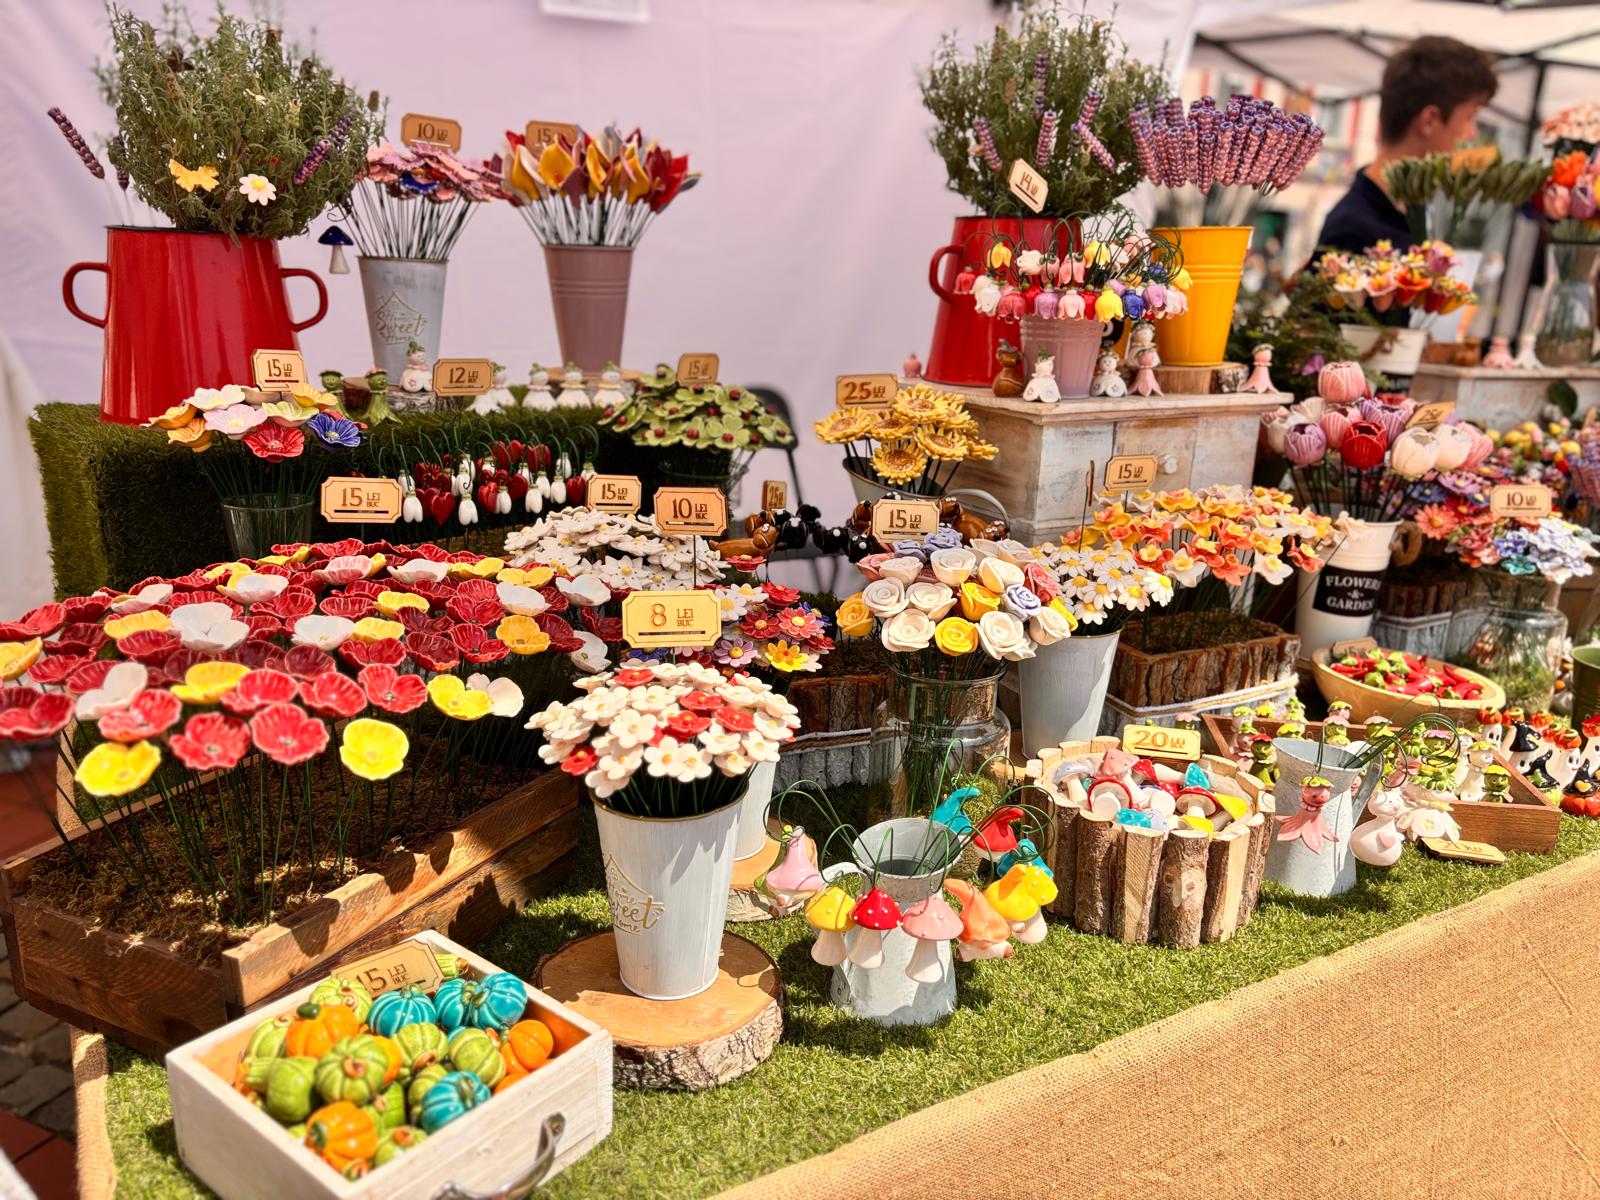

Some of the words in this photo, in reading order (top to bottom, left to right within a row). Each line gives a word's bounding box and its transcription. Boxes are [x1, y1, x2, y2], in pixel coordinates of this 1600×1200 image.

[417, 122, 435, 139] 10
[537, 127, 551, 143] 15
[375, 311, 425, 336] Sweet
[267, 358, 282, 377] 15
[449, 367, 466, 384] 12
[688, 359, 700, 376] 15
[843, 381, 872, 400] 25
[1118, 463, 1133, 479] 15
[341, 487, 363, 507] 15
[366, 492, 381, 500] LEI
[601, 483, 616, 500] 15
[617, 487, 628, 495] LEI
[1506, 491, 1524, 506] 10
[672, 497, 693, 519] 10
[694, 503, 708, 512] LEI
[695, 512, 708, 520] BUC
[888, 509, 907, 528] 15
[909, 514, 922, 523] LEI
[1326, 596, 1375, 610] GARDEN
[650, 603, 667, 627] 8
[676, 608, 694, 619] LEI
[676, 618, 694, 627] BUC
[1133, 730, 1169, 747] 20
[1170, 737, 1186, 746] LEI
[356, 967, 387, 991] 15
[386, 963, 408, 978] LEI
